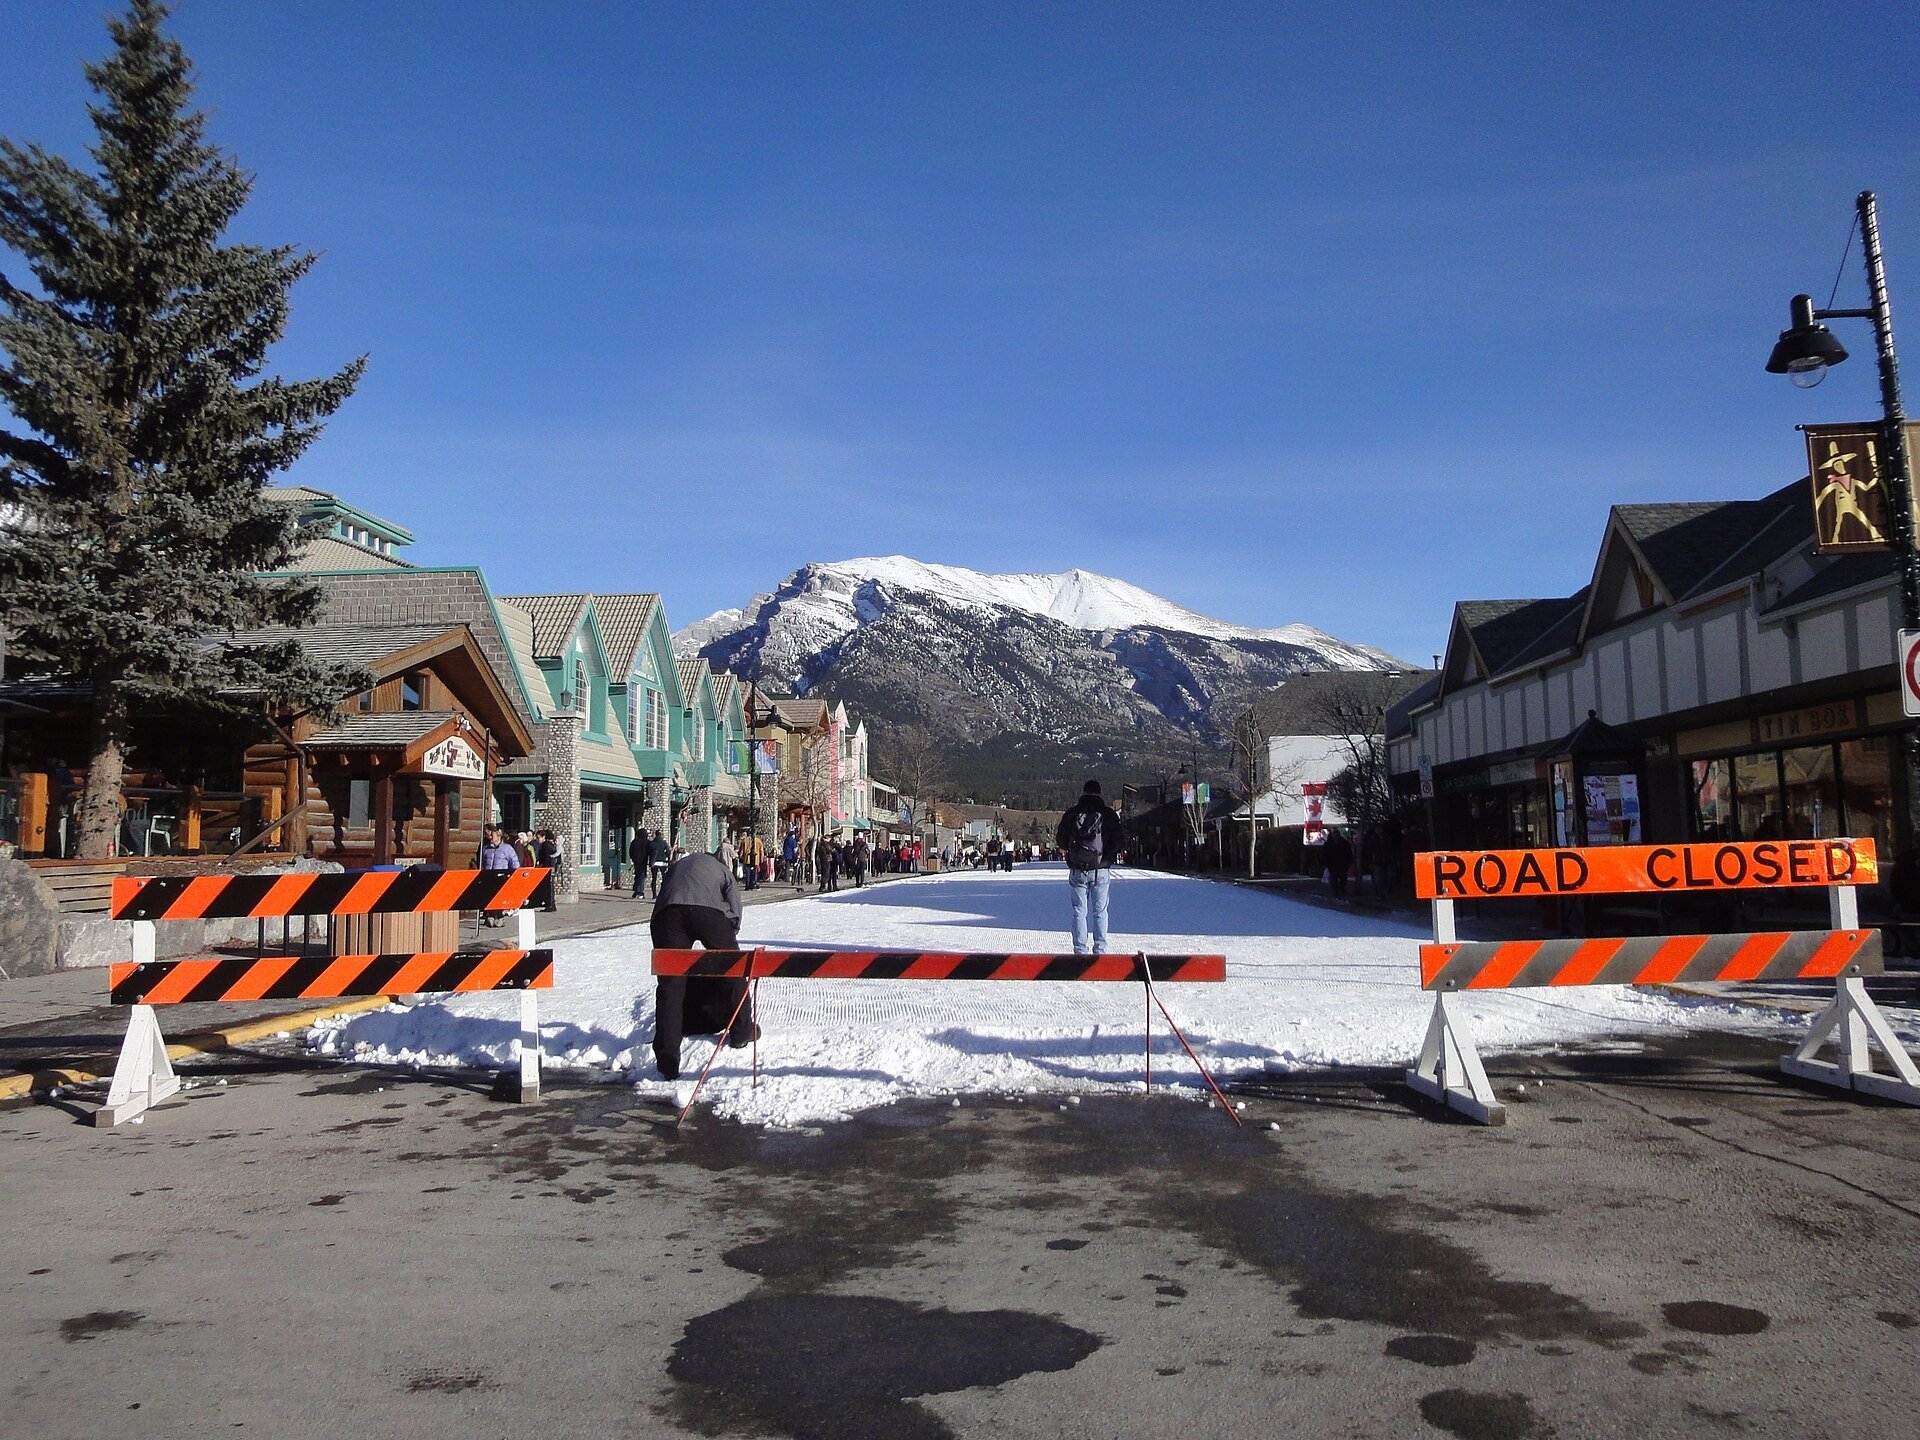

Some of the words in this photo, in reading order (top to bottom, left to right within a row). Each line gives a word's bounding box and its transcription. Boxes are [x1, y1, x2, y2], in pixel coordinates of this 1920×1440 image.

[1807, 704, 1850, 731] BOX
[1433, 851, 1589, 896] ROAD
[1646, 843, 1857, 888] CLOSED
